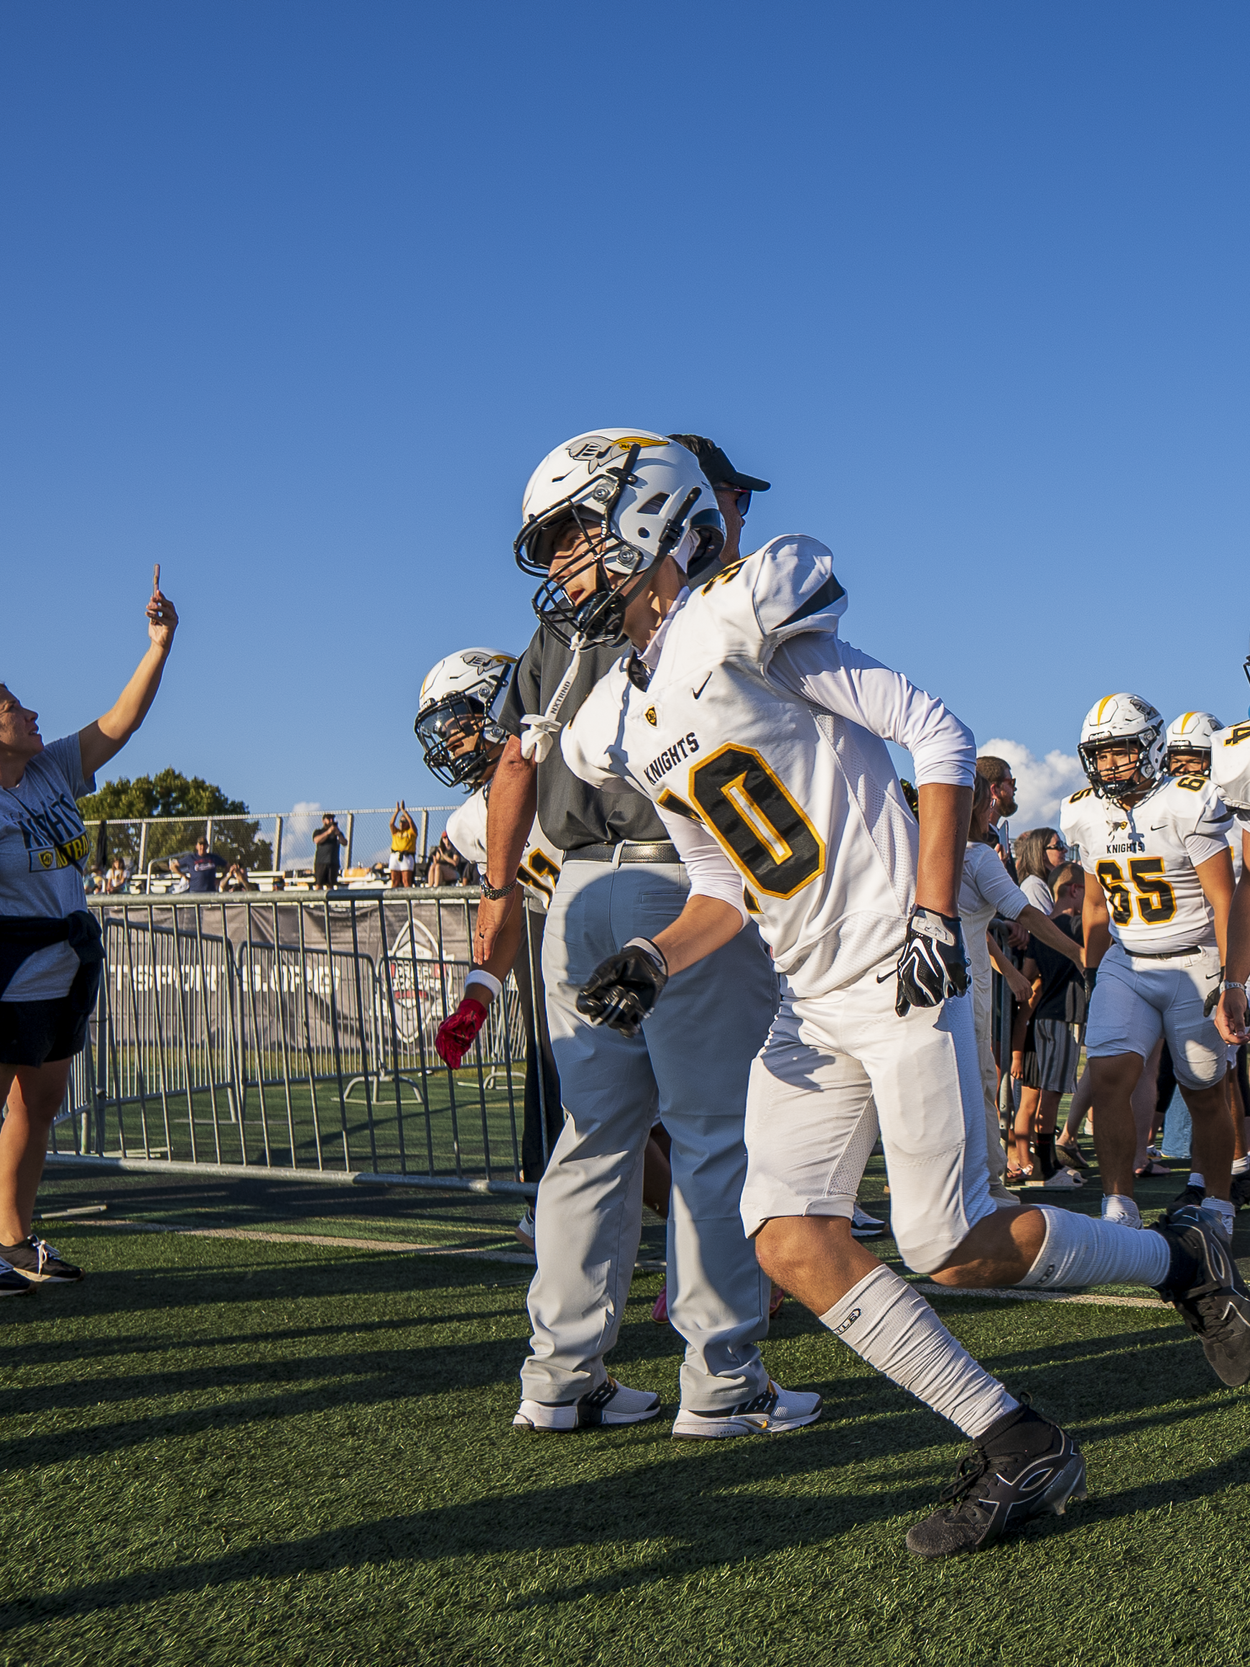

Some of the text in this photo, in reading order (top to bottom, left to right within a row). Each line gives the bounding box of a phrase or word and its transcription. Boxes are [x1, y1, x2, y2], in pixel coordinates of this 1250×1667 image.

[550, 680, 571, 715] NXTRND
[643, 731, 701, 786] KNIGHTS
[1106, 842, 1144, 854] KNIGHTS
[1096, 856, 1177, 927] 65
[100, 964, 341, 993] TSPORS.ORG
